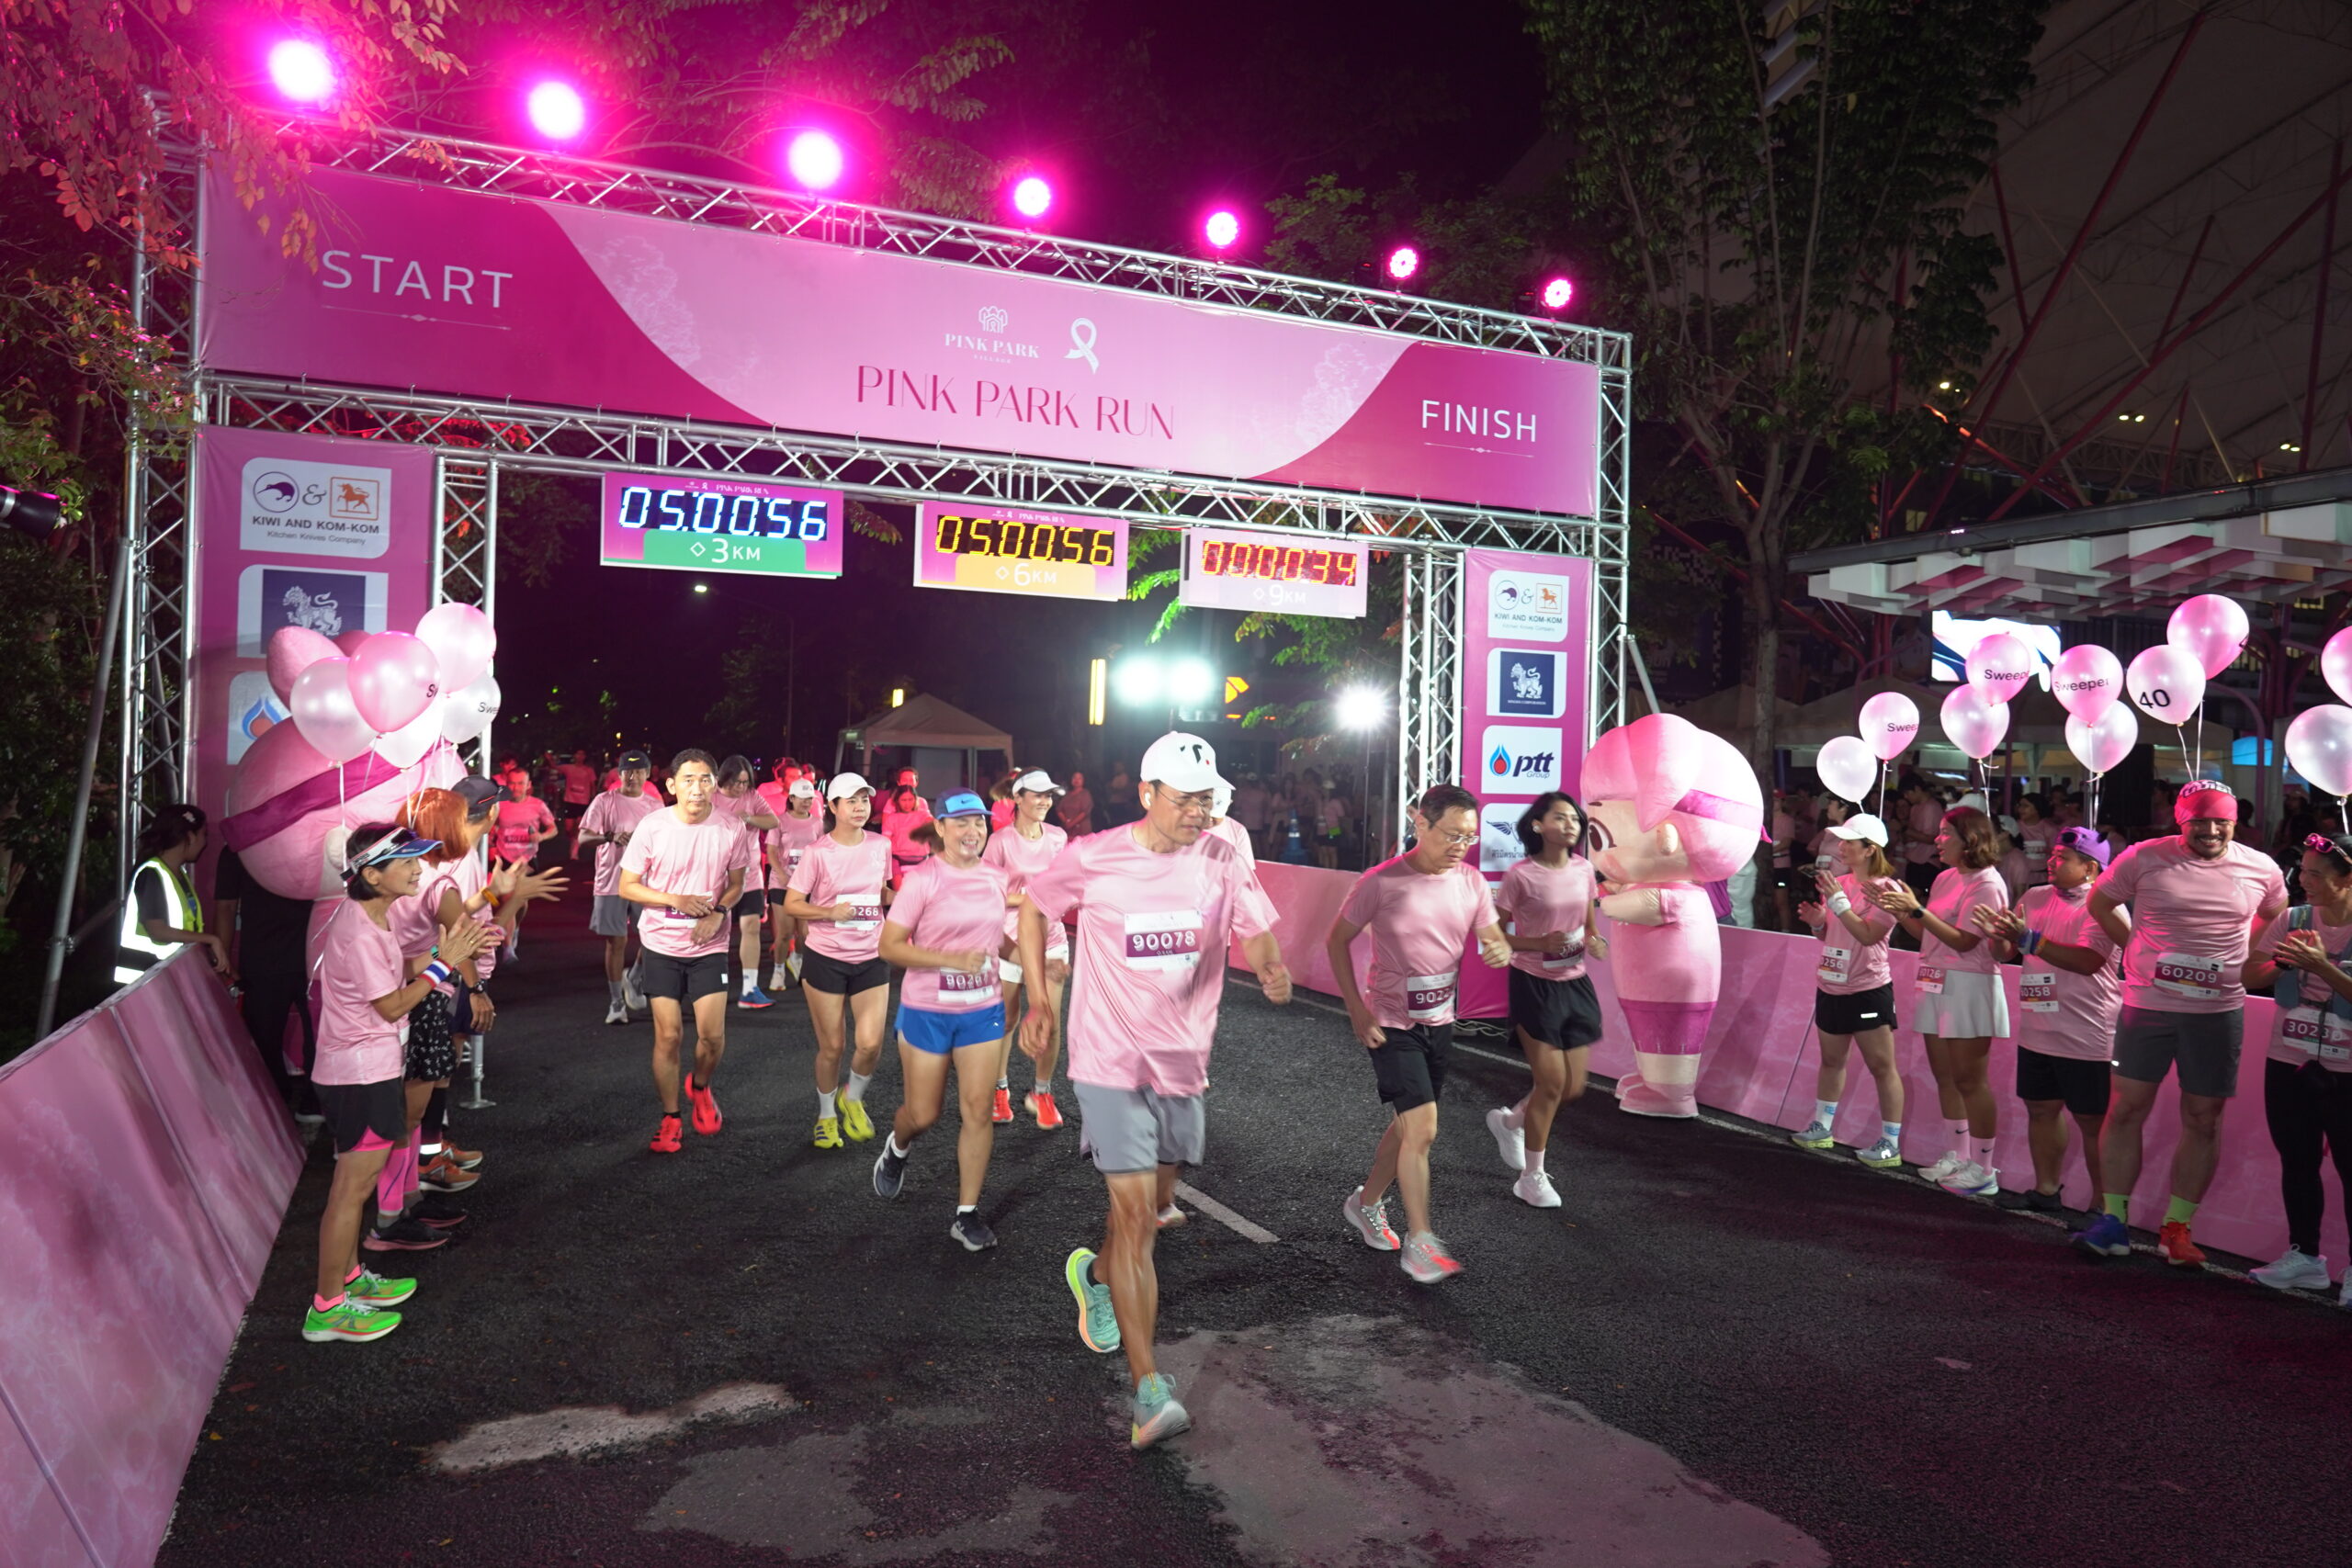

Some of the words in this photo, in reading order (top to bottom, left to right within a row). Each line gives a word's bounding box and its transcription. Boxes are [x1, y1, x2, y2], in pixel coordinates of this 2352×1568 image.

[321, 249, 514, 309] START
[944, 333, 989, 352] PINK
[992, 339, 1040, 358] PARK
[856, 365, 957, 414] PINK
[975, 379, 1080, 429] PARK
[1096, 395, 1175, 440] RUN
[1420, 399, 1537, 443] FINISH
[253, 515, 280, 526] KIWI
[285, 518, 312, 529] AND
[316, 521, 380, 535] KOM-KOM
[267, 530, 298, 540] Kitchen
[300, 532, 326, 542] Knives
[328, 535, 367, 546] Company
[1528, 615, 1563, 624] KOM-KOM
[2139, 688, 2171, 709] 40
[1512, 751, 1555, 777] ptt
[1526, 771, 1551, 780] Group
[1132, 930, 1196, 952] 90078
[2161, 965, 2217, 984] 60209
